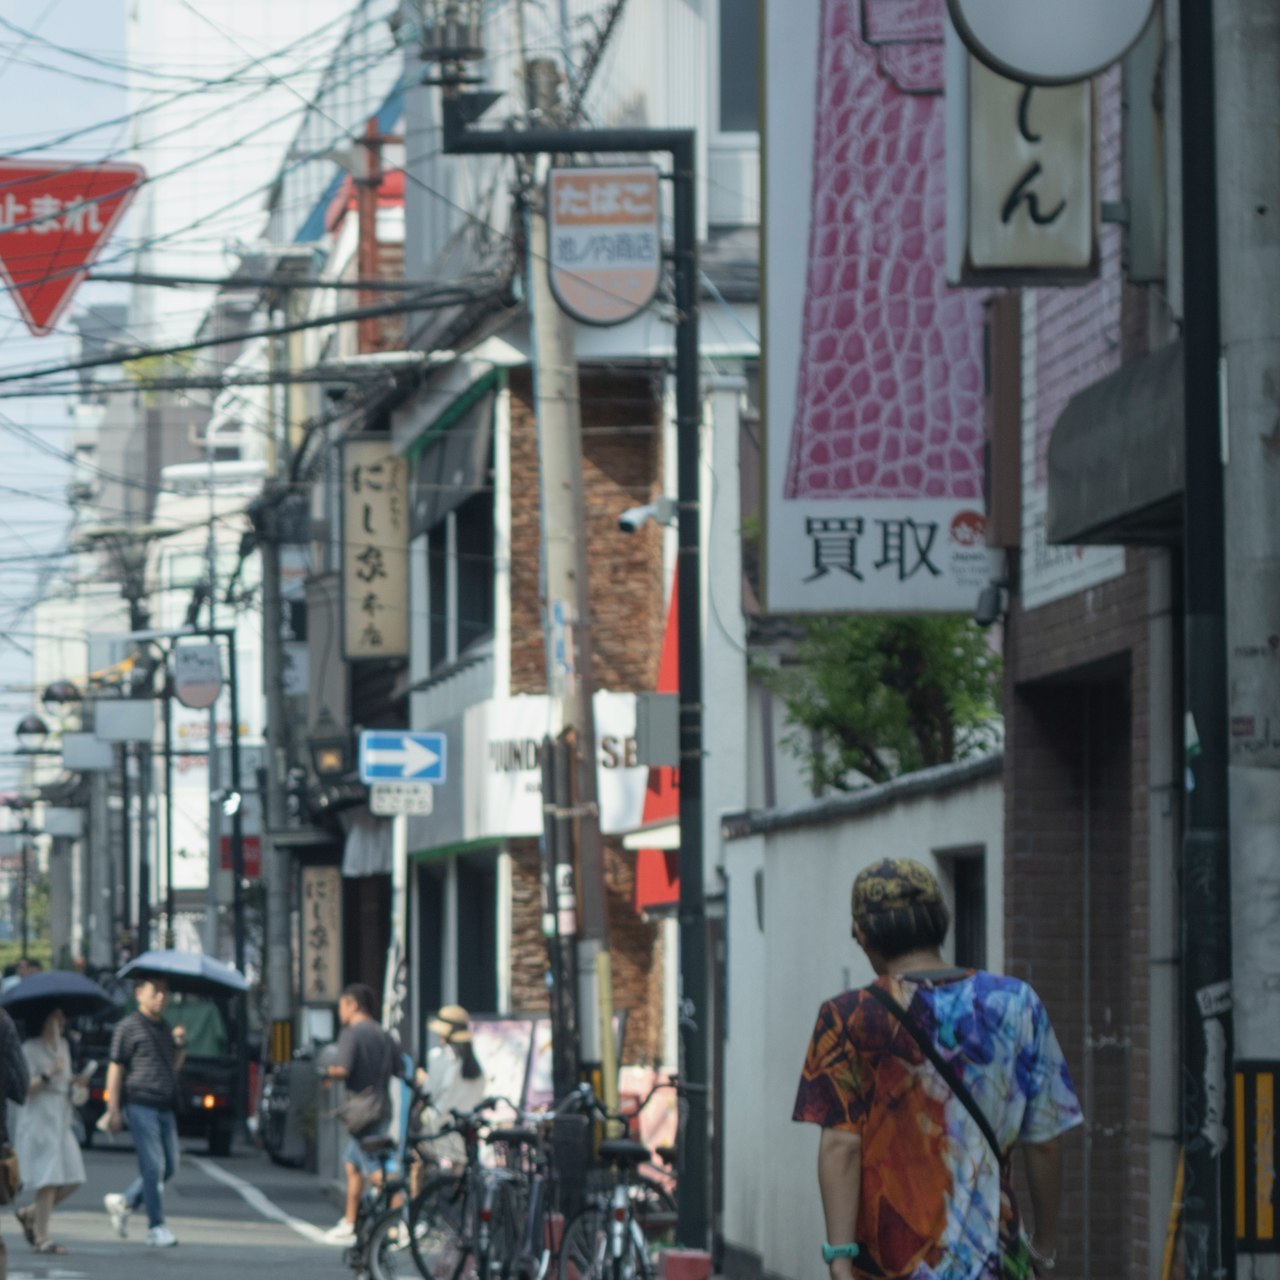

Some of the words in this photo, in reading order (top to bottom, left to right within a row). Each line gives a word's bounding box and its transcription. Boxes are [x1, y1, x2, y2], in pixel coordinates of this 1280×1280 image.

[558, 182, 653, 217] たばこ
[802, 516, 944, 584] 買取
